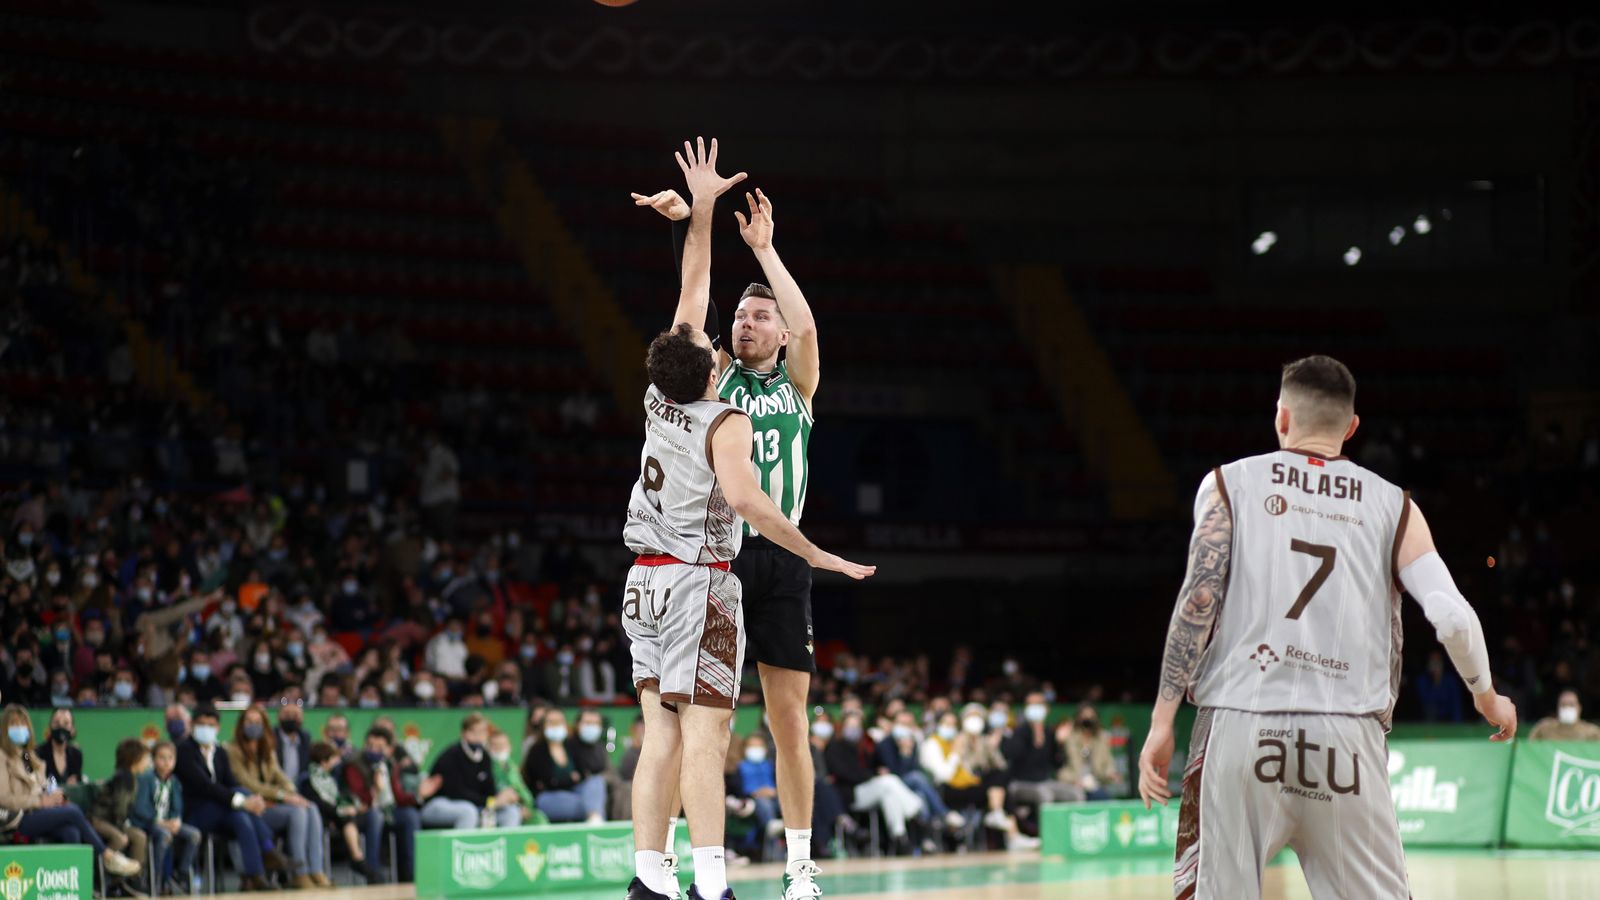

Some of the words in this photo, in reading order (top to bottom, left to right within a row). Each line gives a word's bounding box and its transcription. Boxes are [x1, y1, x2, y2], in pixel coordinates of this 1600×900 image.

[754, 429, 780, 463] 13
[1271, 463, 1362, 502] SALASH
[1326, 513, 1365, 527] HEREDA
[1285, 538, 1337, 620] 7
[1285, 645, 1350, 671] Recoletas
[1259, 728, 1293, 738] GRUPO
[1254, 728, 1360, 796] atu
